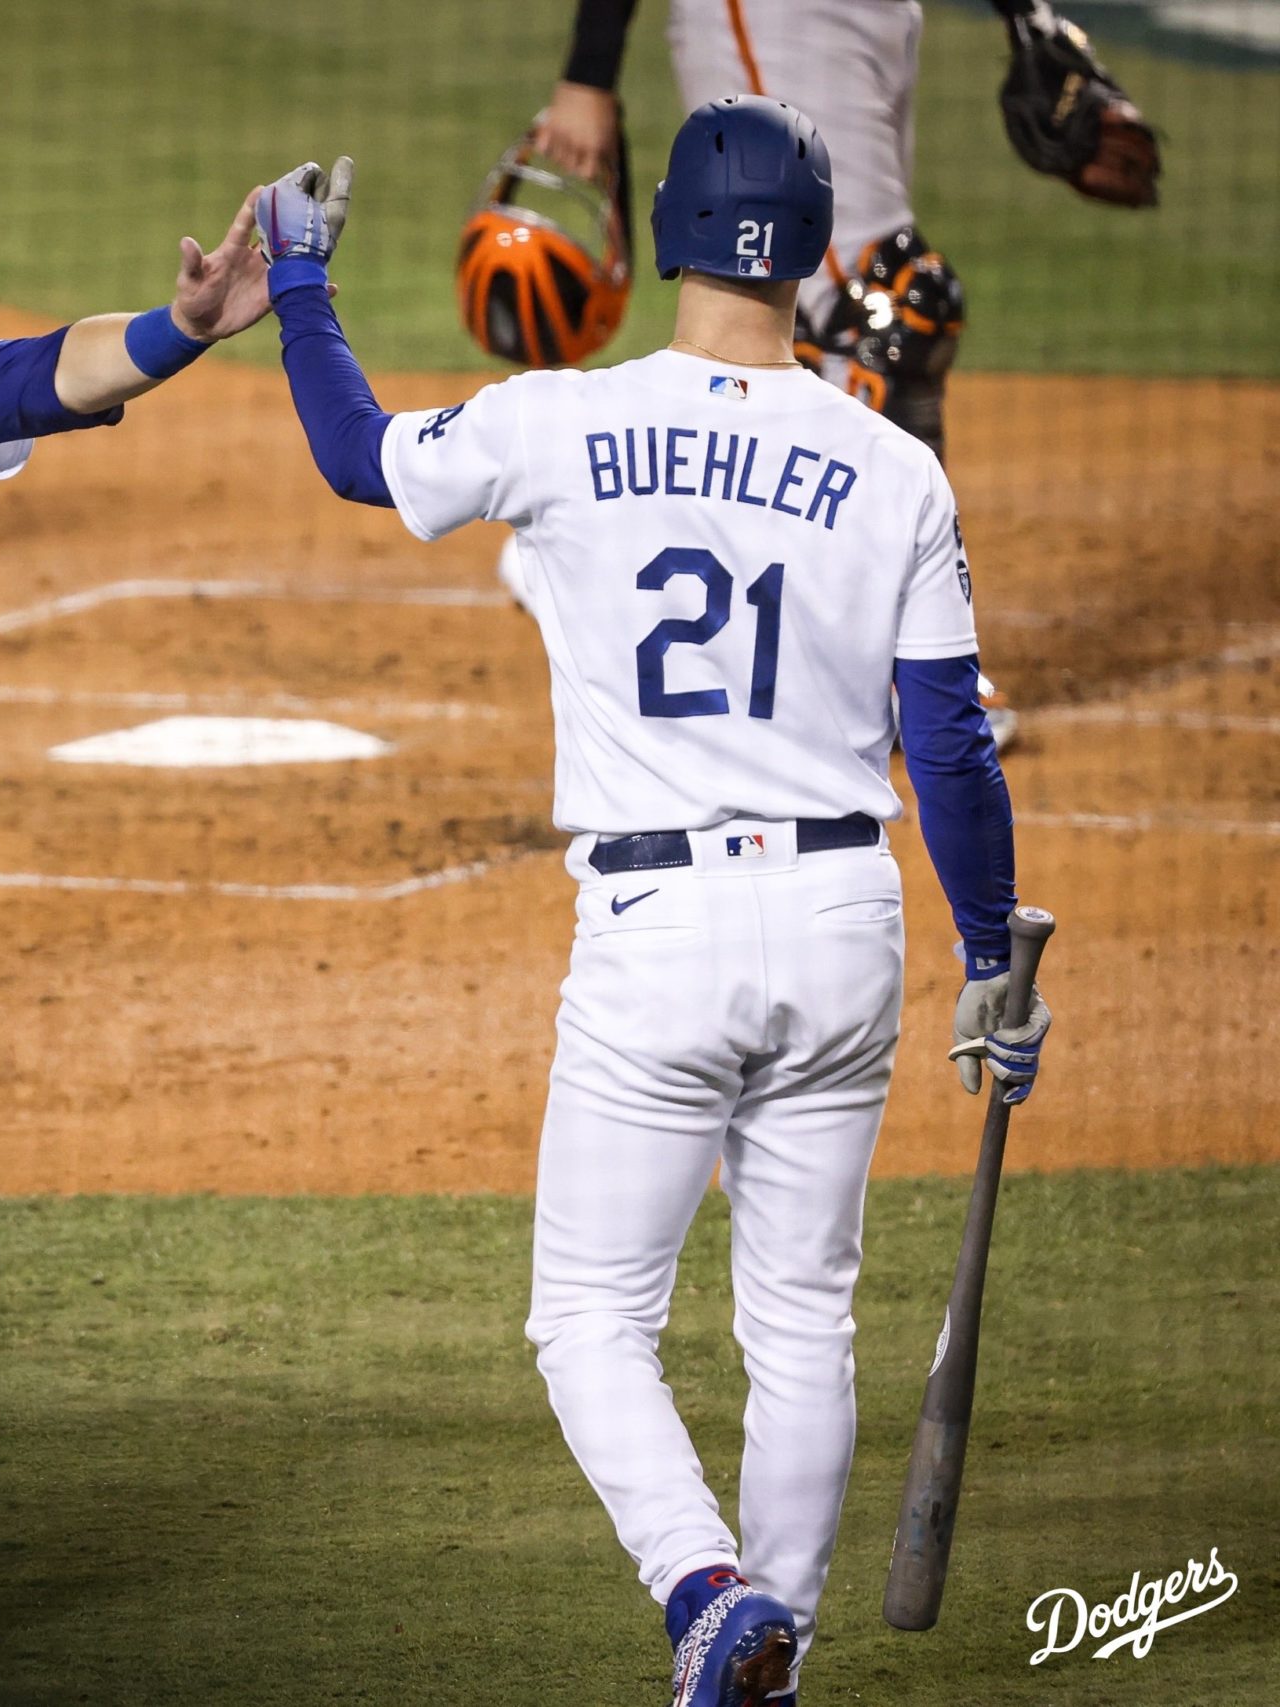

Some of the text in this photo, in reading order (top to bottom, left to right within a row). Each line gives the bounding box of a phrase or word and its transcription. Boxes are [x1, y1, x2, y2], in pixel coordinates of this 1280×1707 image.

[737, 219, 774, 257] 21
[586, 427, 857, 530] BUEHLER
[636, 547, 785, 720] 21
